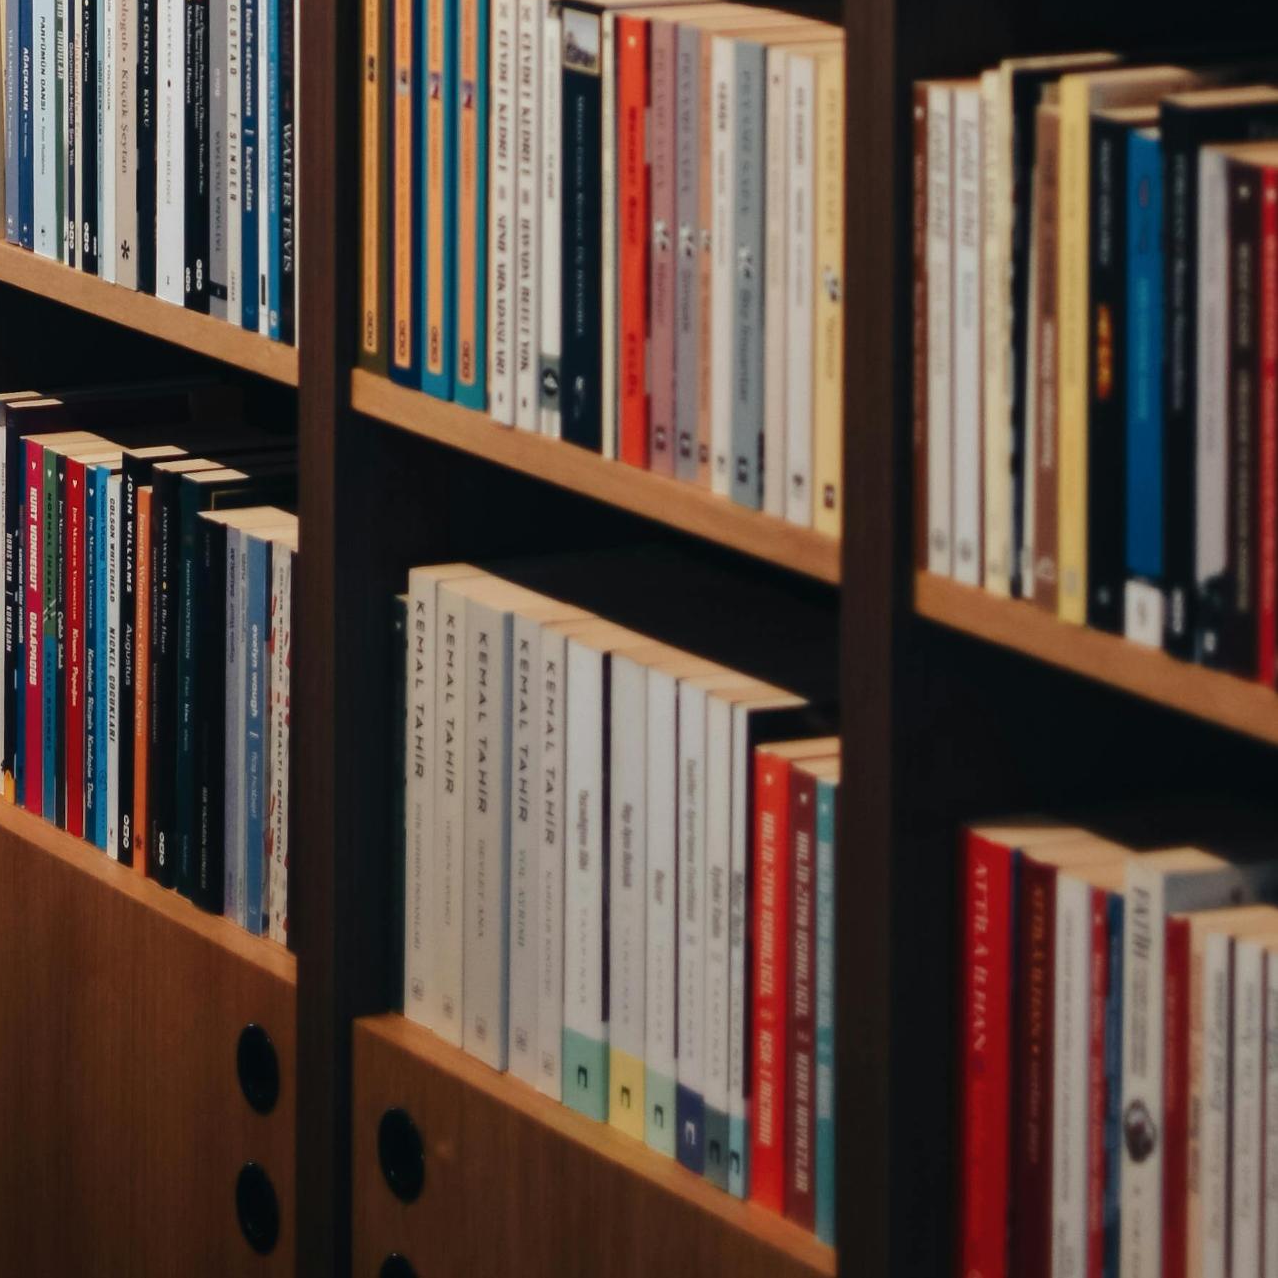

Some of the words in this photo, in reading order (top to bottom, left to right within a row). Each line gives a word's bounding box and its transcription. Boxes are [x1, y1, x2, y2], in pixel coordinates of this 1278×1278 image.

[229, 132, 237, 203] SINGER
[283, 123, 292, 207] WALTER
[283, 215, 292, 273] TEVIS
[29, 612, 38, 686] GALÁPAGOS
[416, 601, 425, 689] KEMAL
[445, 614, 455, 704] KEMAL
[478, 632, 488, 722] KEMAL
[519, 639, 529, 730] KEMAL
[416, 703, 425, 779] TAHİR
[545, 660, 555, 751] KEMAL
[445, 717, 455, 794] TAHİR
[478, 737, 488, 814] TAHİR
[519, 745, 529, 823] TAHİR
[546, 767, 556, 847] TAHİR
